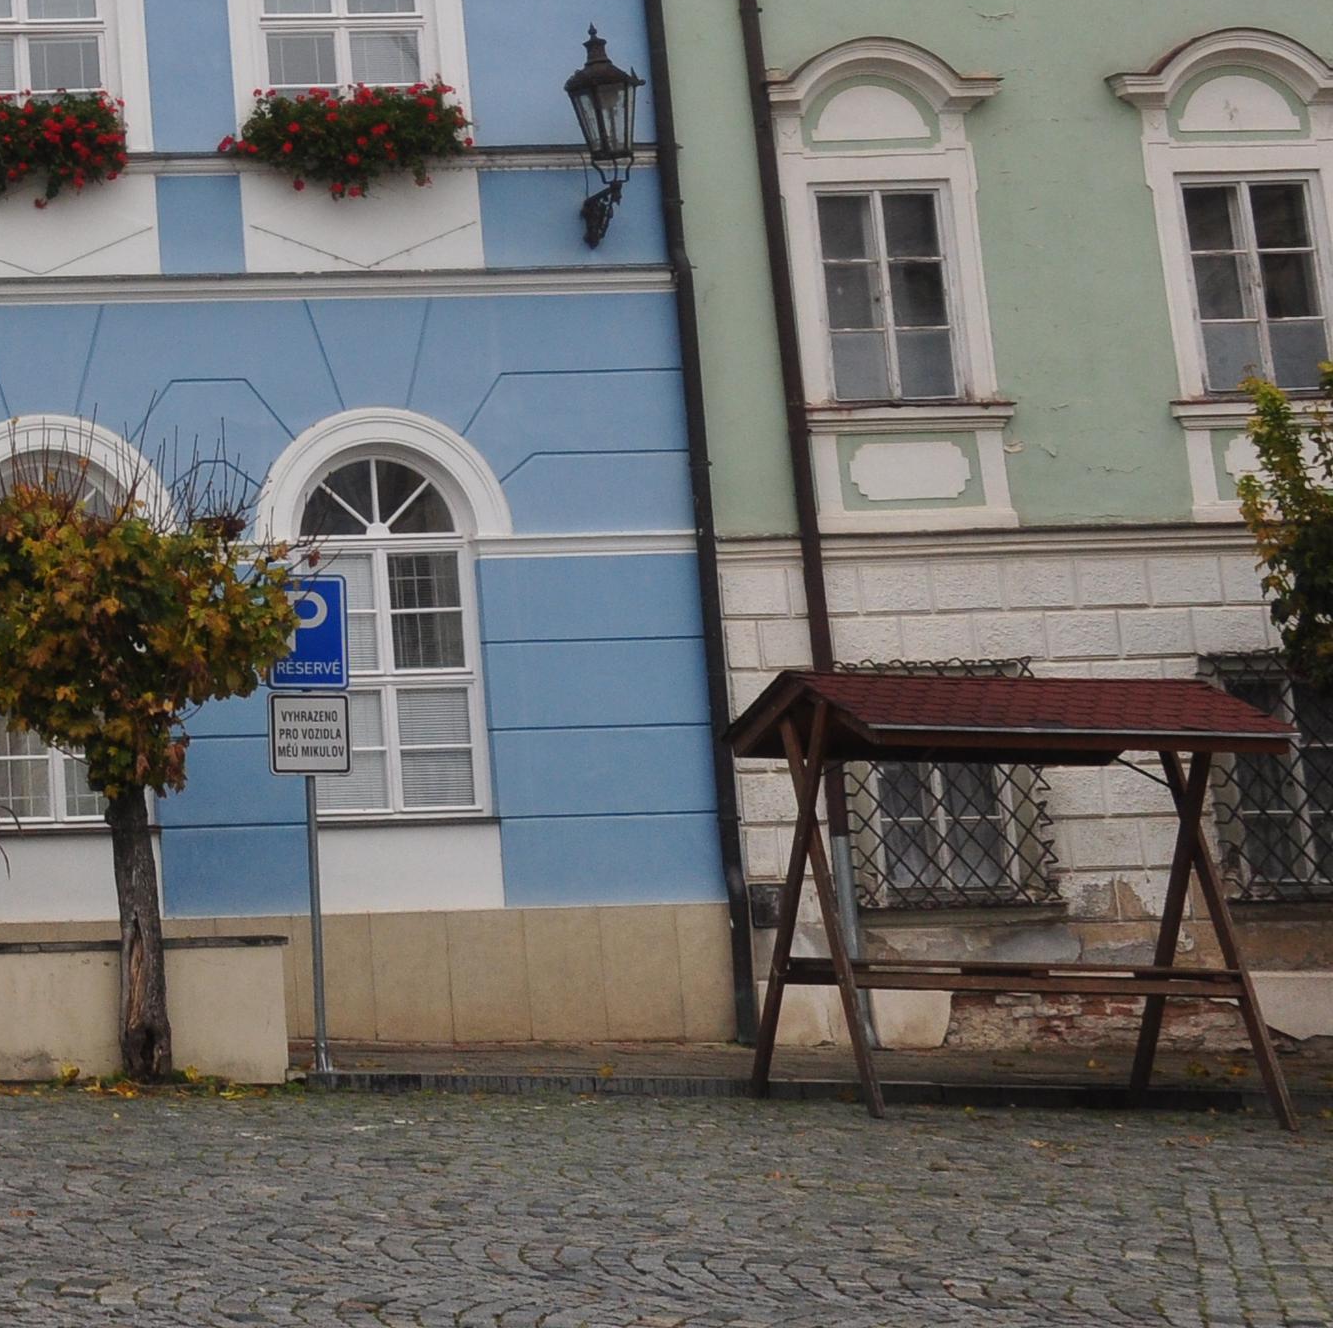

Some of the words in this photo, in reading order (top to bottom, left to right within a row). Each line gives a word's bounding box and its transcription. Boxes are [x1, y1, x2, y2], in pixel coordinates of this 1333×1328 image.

[283, 590, 328, 653] P
[281, 710, 338, 722] VYHRAZENO
[279, 728, 299, 740] PRO
[301, 728, 341, 740] VOZIDLA
[277, 742, 298, 758] MĚÚ
[301, 745, 345, 758] MIKULOV
